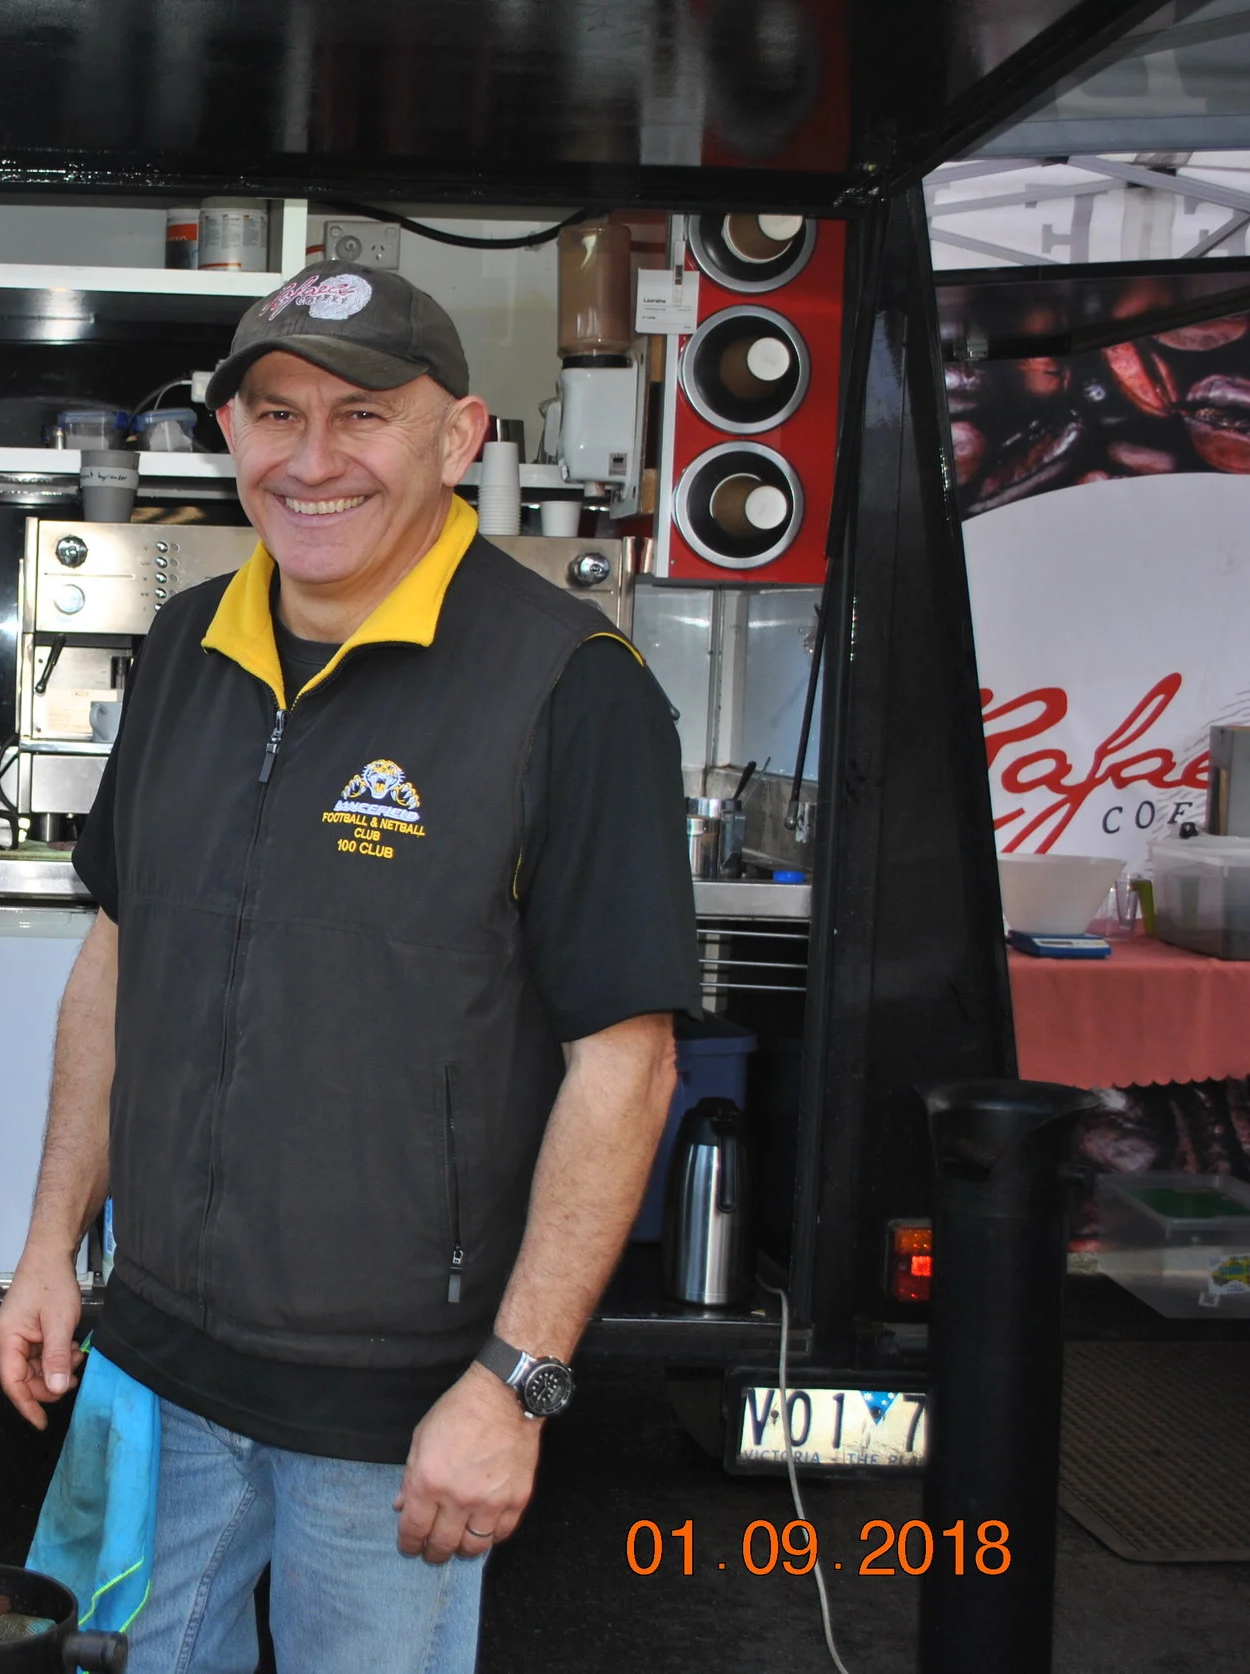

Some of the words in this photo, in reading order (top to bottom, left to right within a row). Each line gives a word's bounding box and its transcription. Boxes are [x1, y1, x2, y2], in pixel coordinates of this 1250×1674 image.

[322, 812, 368, 826] FOOTBALL
[370, 816, 378, 828] &
[380, 818, 426, 836] NETBALL
[1101, 801, 1193, 835] COF
[354, 827, 381, 841] CLUB
[337, 839, 357, 852] 100
[359, 842, 394, 859] CLUB
